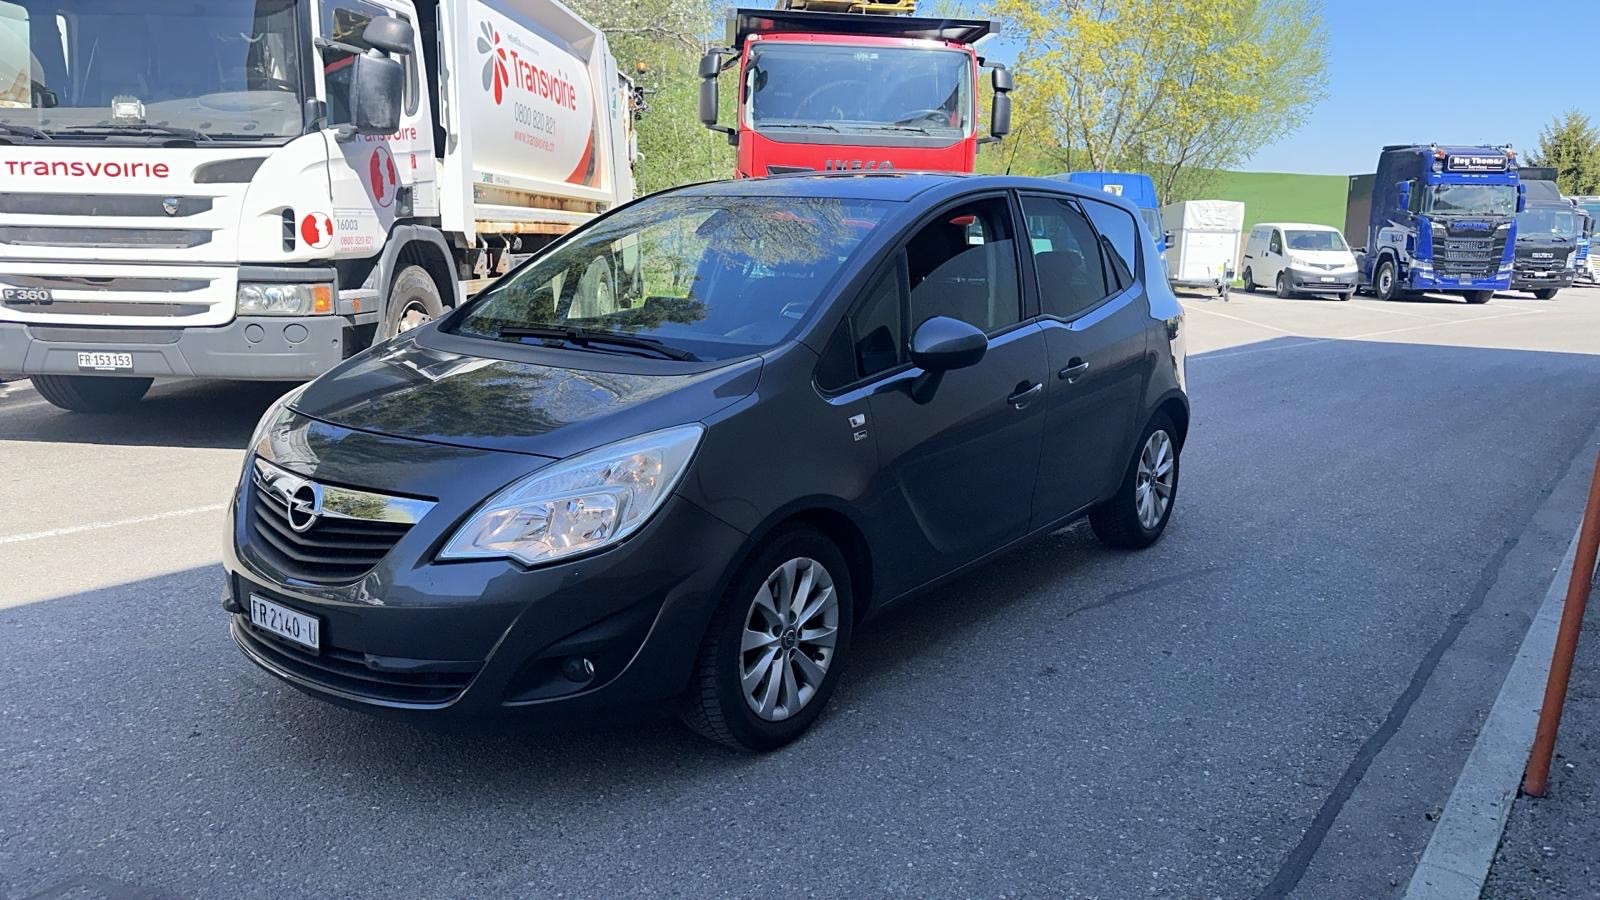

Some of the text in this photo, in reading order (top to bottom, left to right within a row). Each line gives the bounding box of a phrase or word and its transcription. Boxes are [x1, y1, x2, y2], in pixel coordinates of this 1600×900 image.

[510, 50, 576, 110] Transvoirie
[514, 101, 531, 126] 0800
[532, 110, 545, 131] 820
[825, 159, 894, 172] IVECO
[1453, 157, 1503, 166] Rey Thomas
[5, 161, 169, 178] Transvoirie
[336, 219, 358, 231] 16003
[4, 289, 49, 301] P 360
